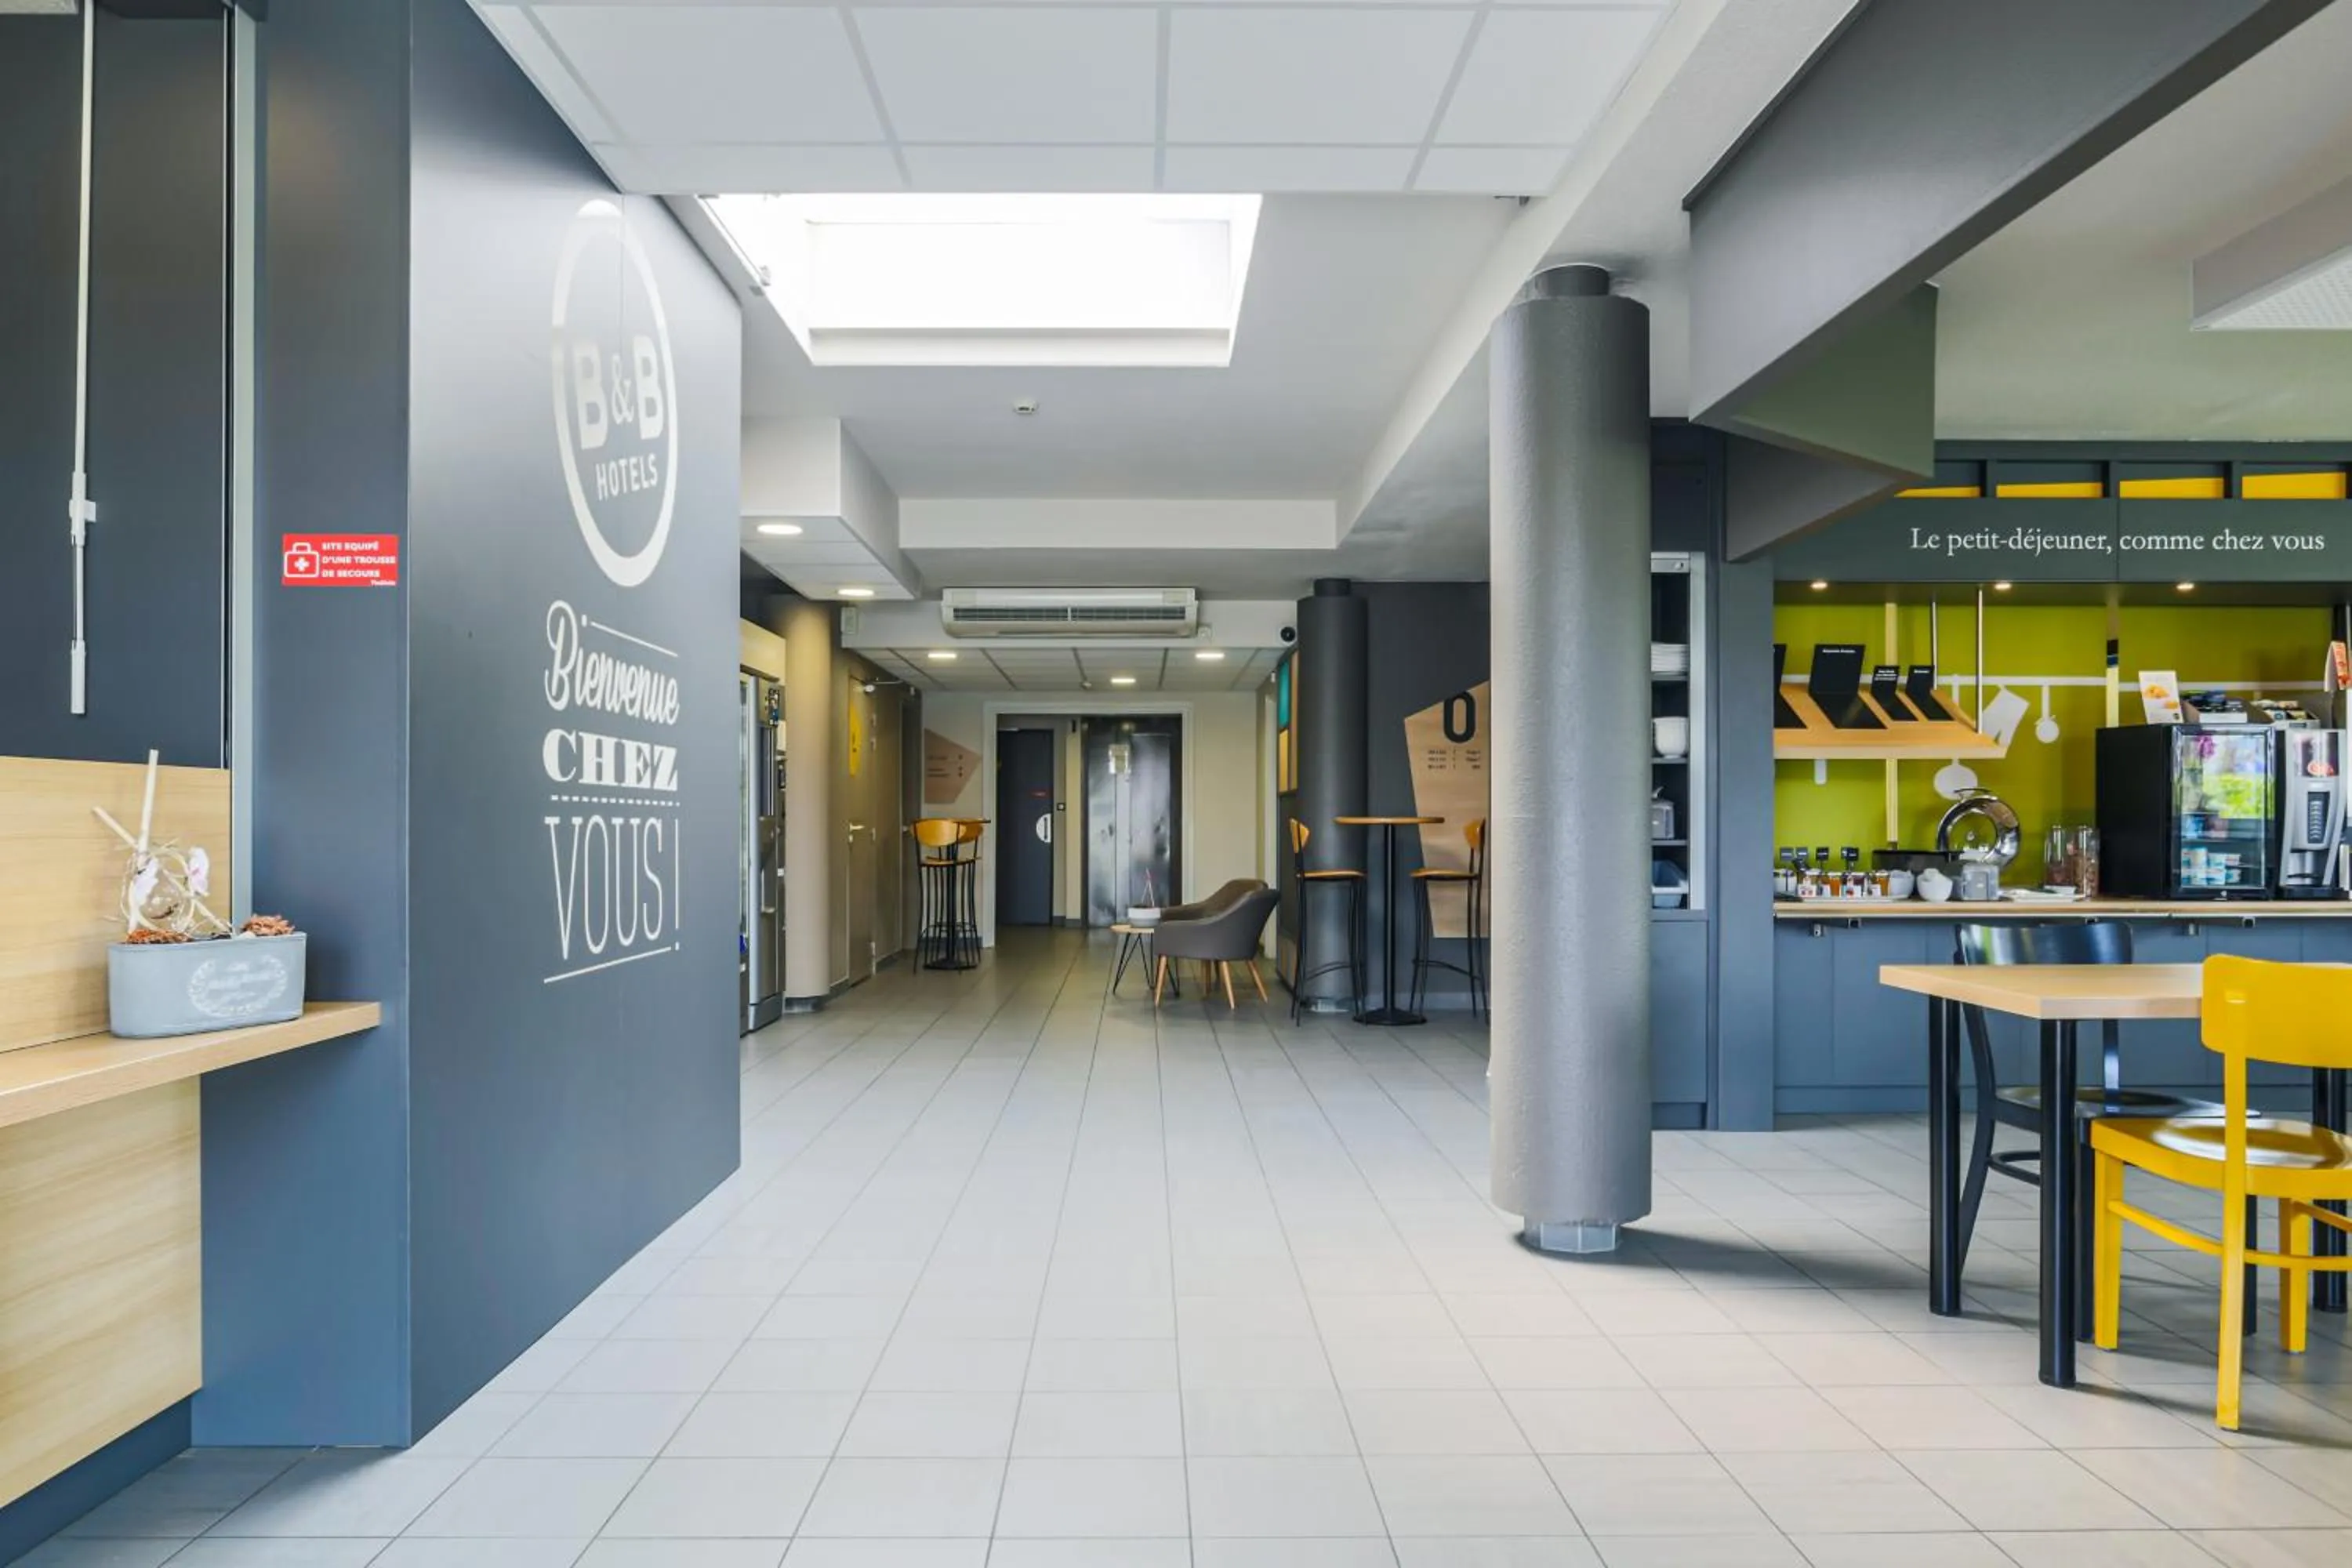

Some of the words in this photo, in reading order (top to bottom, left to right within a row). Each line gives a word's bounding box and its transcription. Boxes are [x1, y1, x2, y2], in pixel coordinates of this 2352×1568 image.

[572, 335, 665, 450] B&B
[595, 452, 659, 501] HOTELS
[321, 541, 343, 551] SITE
[321, 555, 352, 564] D'UNE
[354, 555, 396, 564] TROUSSE
[1910, 528, 1940, 550] Le
[1947, 528, 2112, 556] petit-déjeuner,
[2119, 533, 2205, 550] comme
[2212, 528, 2263, 550] chez
[2271, 533, 2325, 550] vous
[321, 569, 335, 579] DE
[336, 569, 380, 579] SECOURS
[544, 600, 680, 725] Bienvenue
[543, 728, 678, 793] CHEZ
